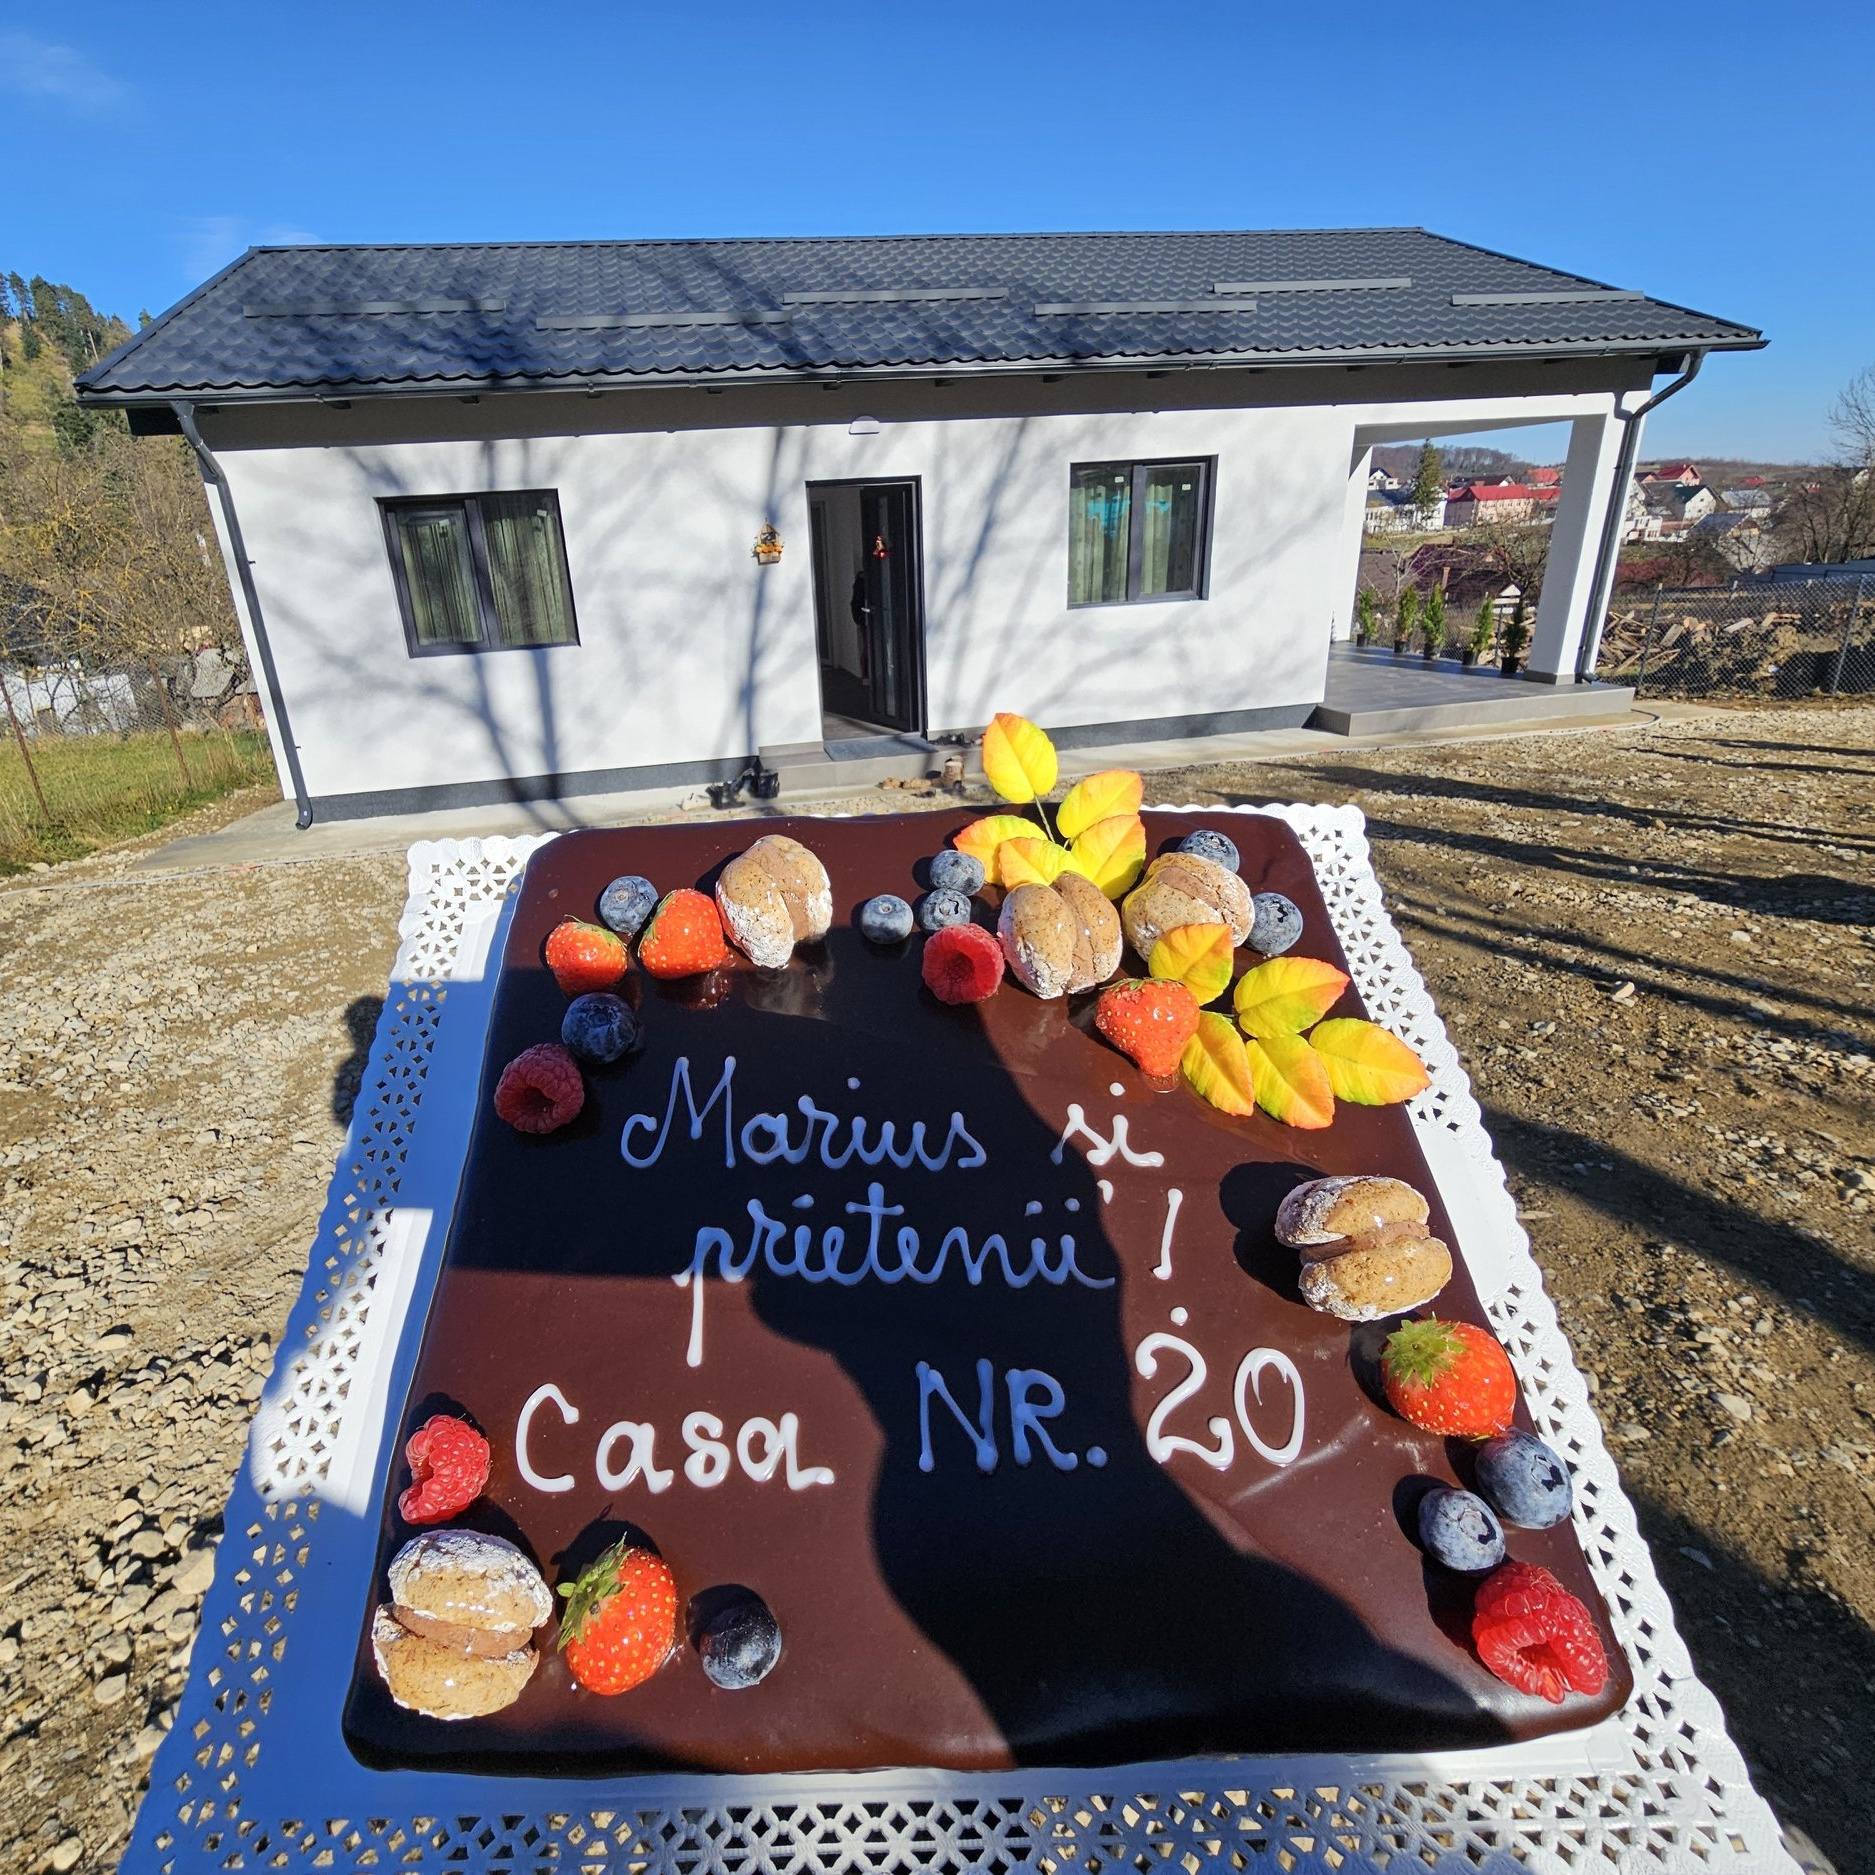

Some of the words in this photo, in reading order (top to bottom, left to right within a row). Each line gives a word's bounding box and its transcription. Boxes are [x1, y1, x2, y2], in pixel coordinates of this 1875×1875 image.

[620, 1055, 987, 1170] Marius
[514, 1383, 835, 1494] Casa
[915, 1357, 1109, 1474] NR.
[1134, 1331, 1305, 1470] 20
